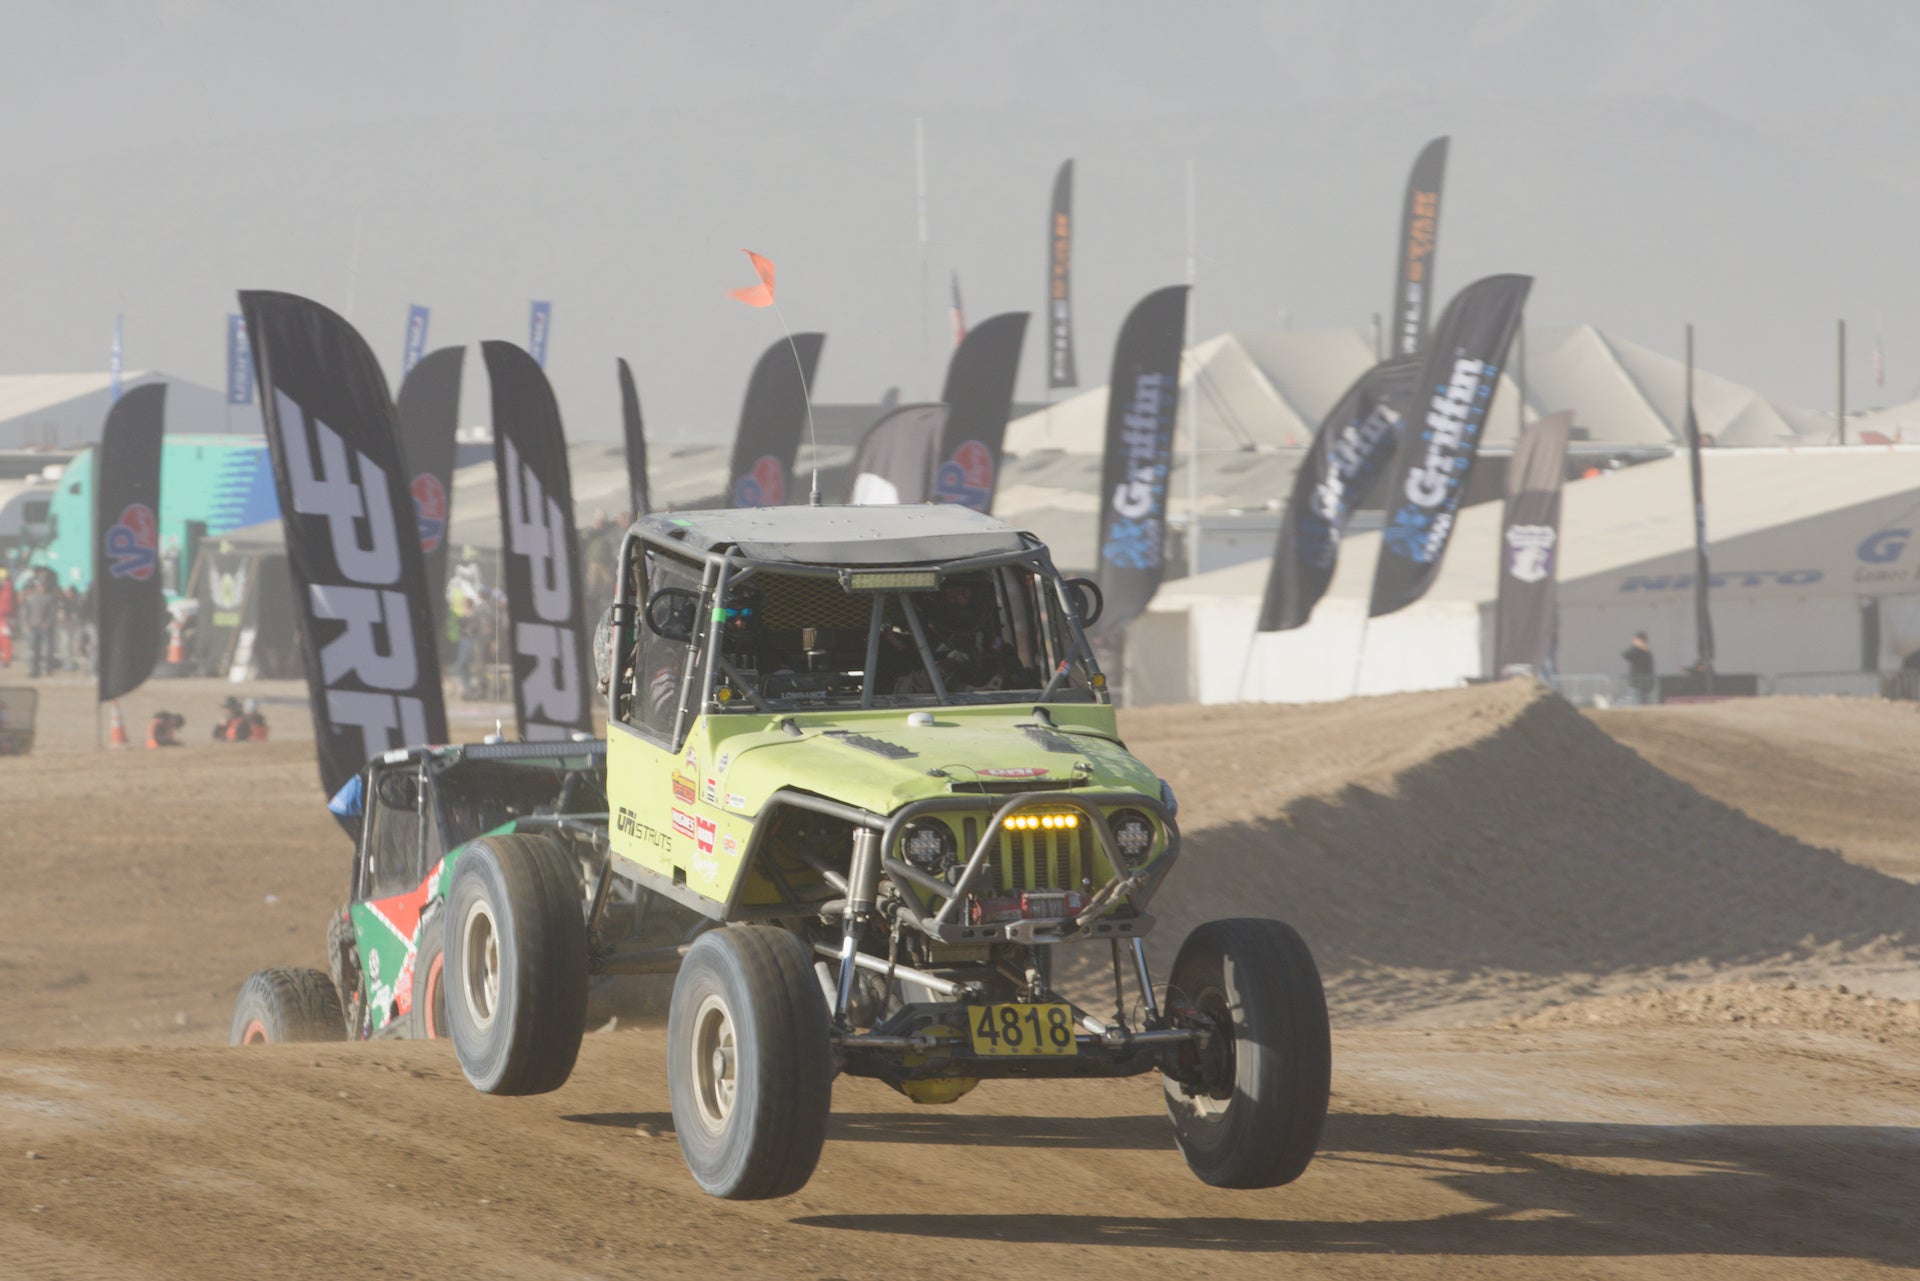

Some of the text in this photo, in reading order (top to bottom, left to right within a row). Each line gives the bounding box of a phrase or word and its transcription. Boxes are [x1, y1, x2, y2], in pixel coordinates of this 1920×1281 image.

[1112, 371, 1163, 519] Griffin
[1405, 357, 1485, 508] Griffin
[635, 822, 673, 853] STRUTS
[977, 1006, 1071, 1047] 4818
